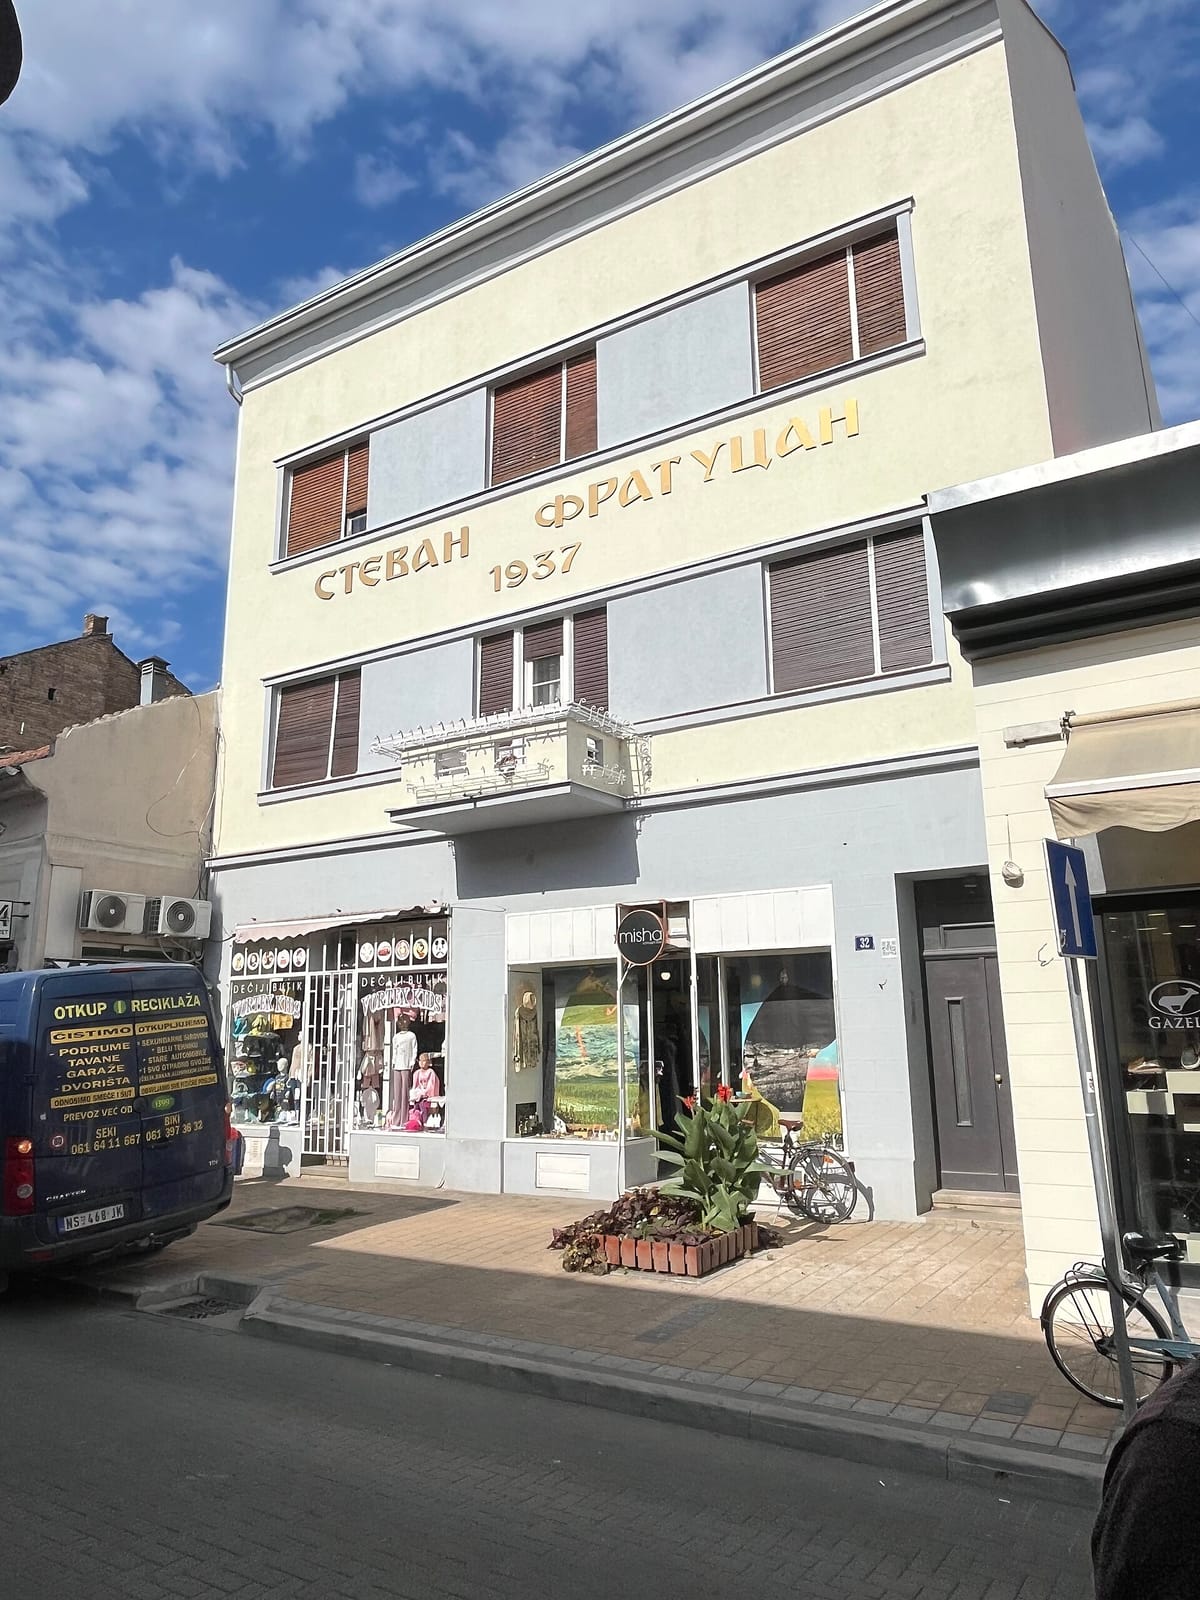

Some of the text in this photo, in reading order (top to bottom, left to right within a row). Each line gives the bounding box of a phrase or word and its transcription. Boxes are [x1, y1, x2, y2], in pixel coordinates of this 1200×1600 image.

[313, 397, 861, 601] СТЕВАН ФРАТУЦАН
[489, 541, 583, 593] 1937
[619, 927, 663, 944] misha
[859, 937, 870, 949] 32
[408, 973, 443, 985] BUTIK
[233, 981, 303, 994] DEČIJI BUTIK
[54, 1002, 108, 1020] OTKUP
[132, 992, 201, 1012] RECIKLAŽA
[360, 987, 442, 1016] VORTEX KIDS
[59, 1042, 131, 1057] PODRUME
[68, 1054, 120, 1067] TAVANE
[148, 1055, 168, 1064] STARE
[66, 1064, 125, 1078] GARAŽE
[62, 1076, 131, 1092] DVORIŠTA
[63, 1110, 99, 1122] PREVOZ
[120, 1105, 133, 1114] OD
[164, 1114, 180, 1126] BIKI
[96, 1126, 116, 1139] SEKI
[146, 1129, 161, 1142] 061
[165, 1120, 180, 1133] 397
[193, 1119, 203, 1131] 32
[71, 1144, 90, 1155] 061
[108, 1137, 120, 1149] 11
[124, 1133, 141, 1146] 667
[66, 1216, 80, 1230] NS
